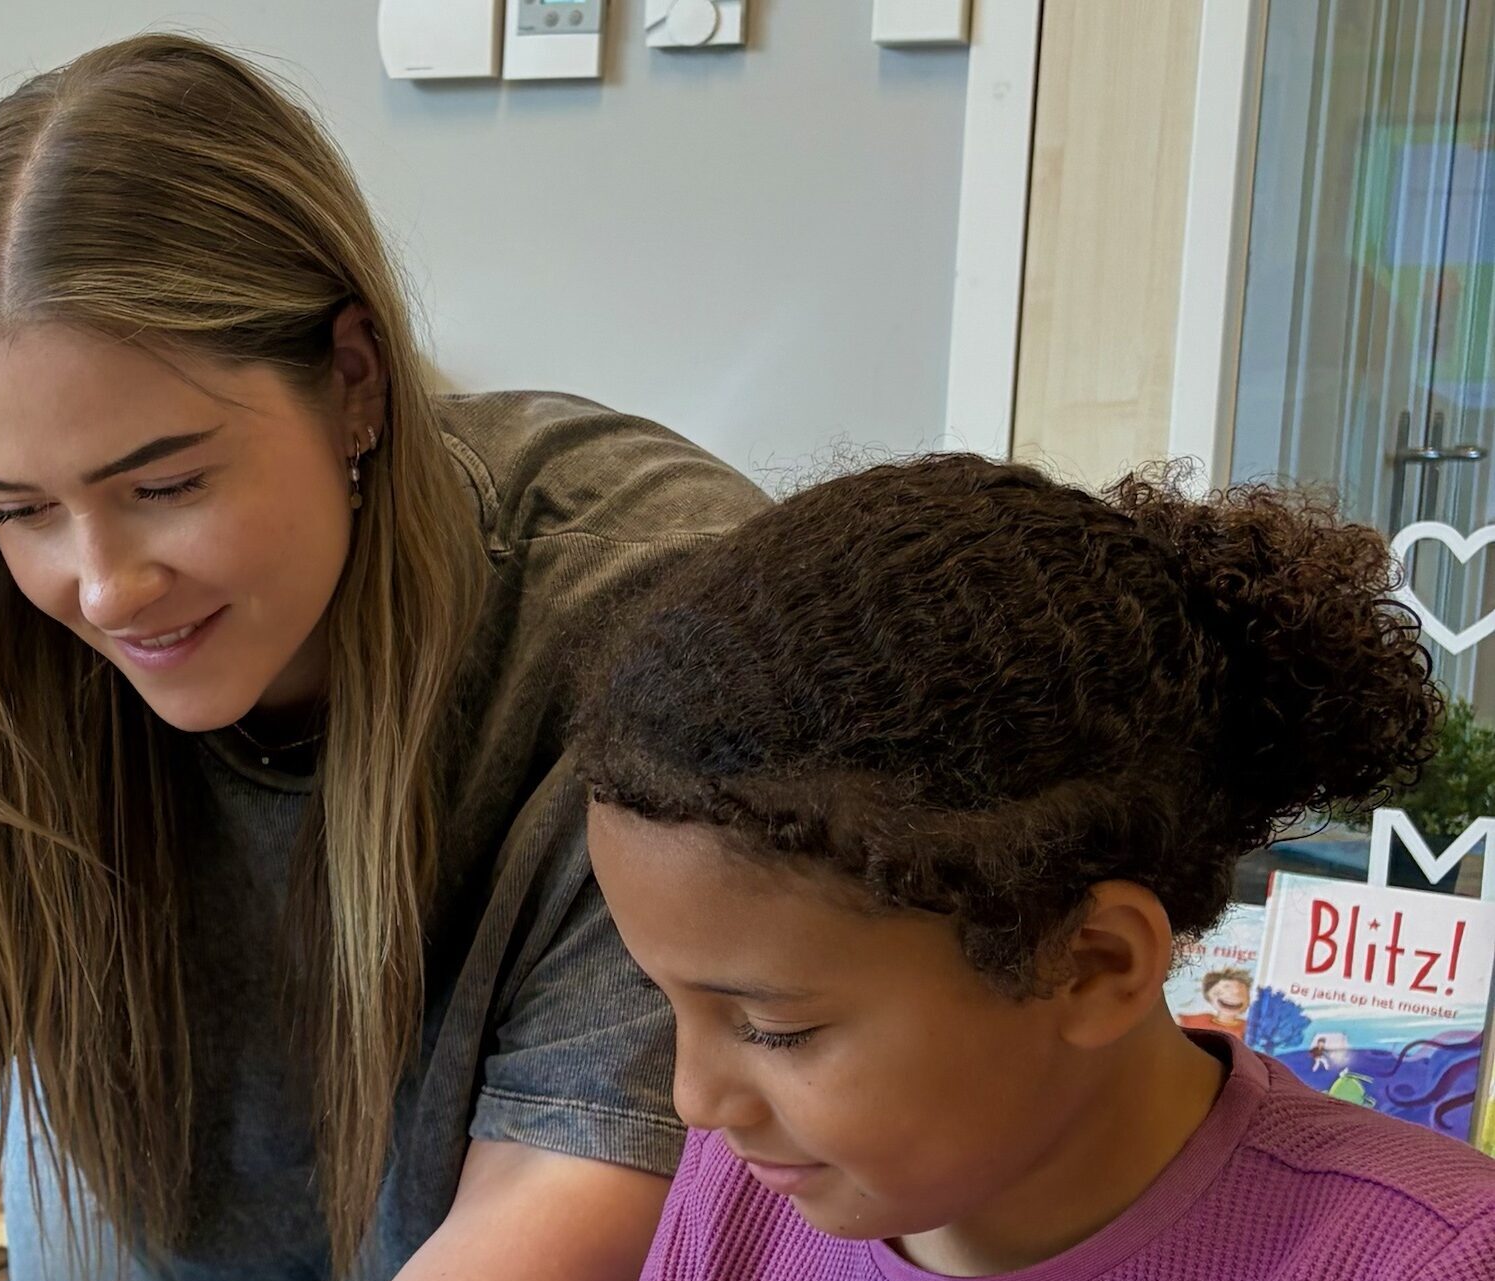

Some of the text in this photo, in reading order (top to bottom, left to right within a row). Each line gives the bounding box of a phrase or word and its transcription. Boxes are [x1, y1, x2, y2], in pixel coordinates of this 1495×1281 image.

[1305, 899, 1466, 996] Blitz!
[1290, 982, 1459, 1019] De jacht op het monster
